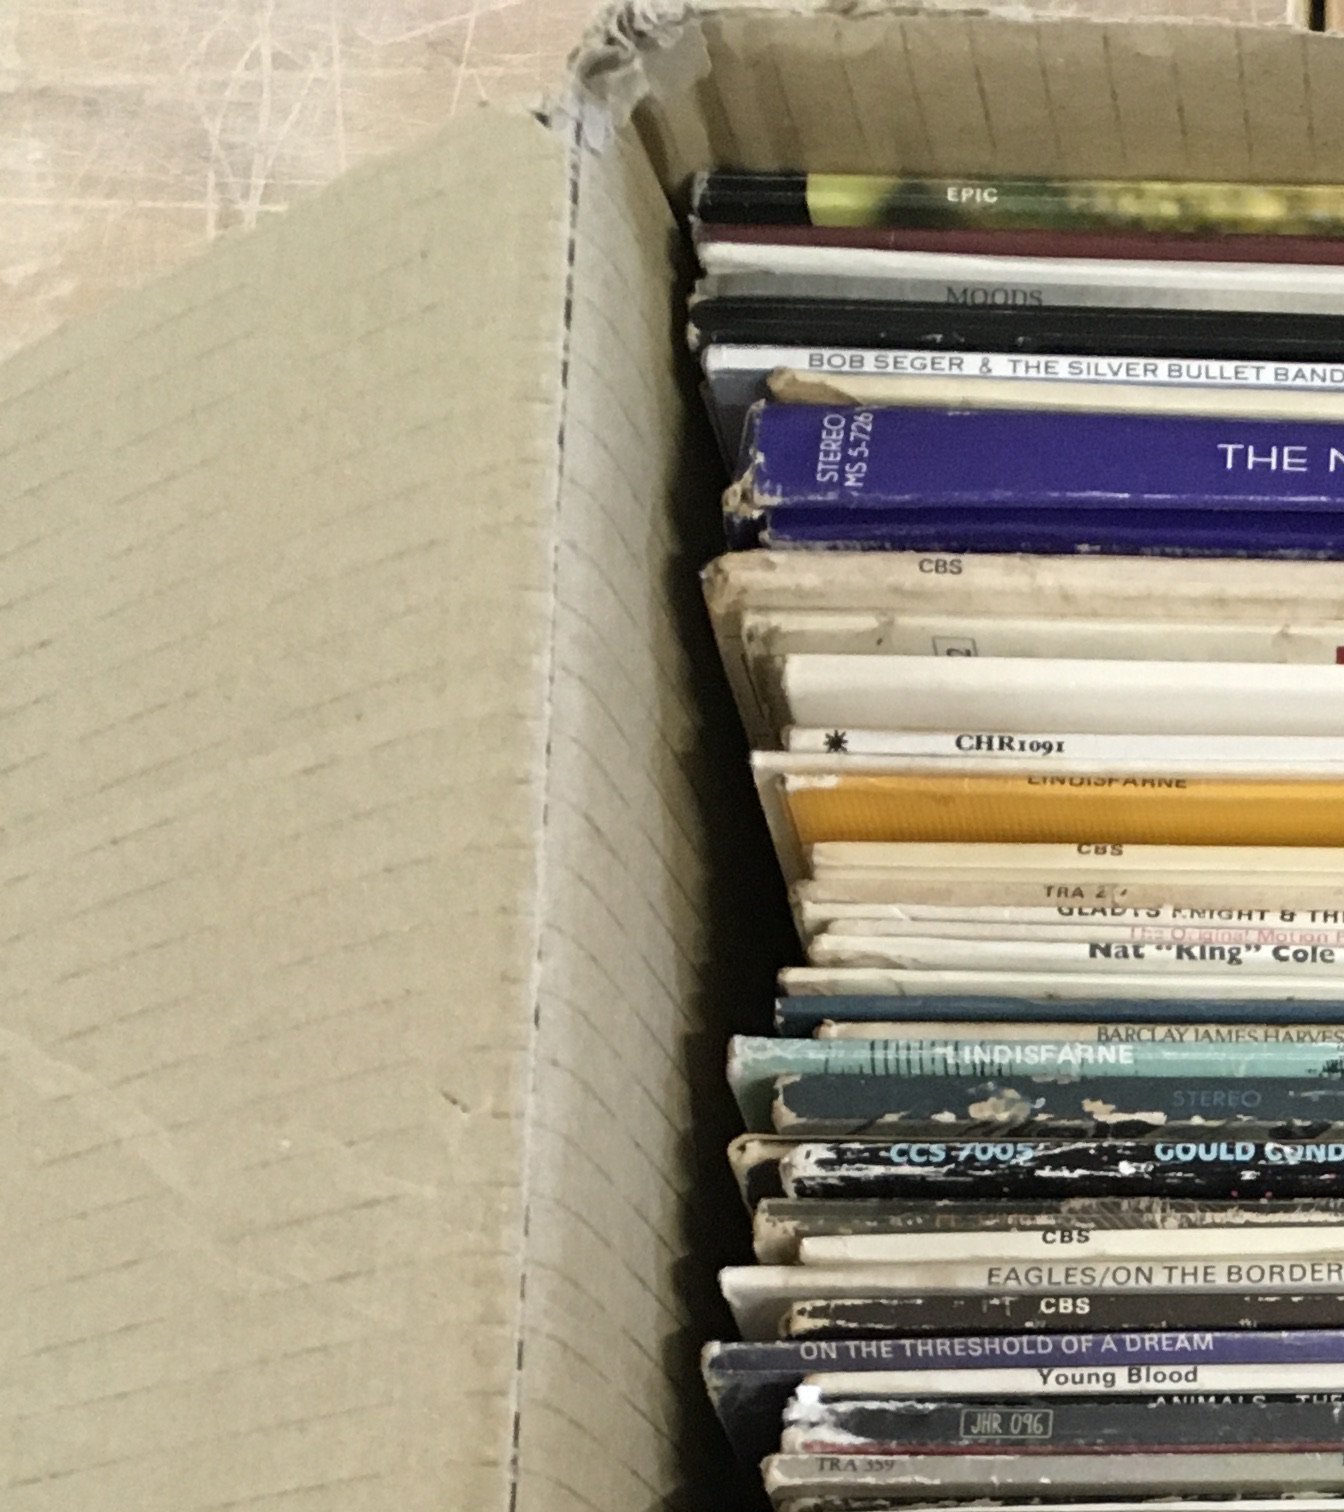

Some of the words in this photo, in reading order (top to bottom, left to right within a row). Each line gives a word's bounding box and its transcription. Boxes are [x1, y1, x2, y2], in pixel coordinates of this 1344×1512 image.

[947, 187, 998, 203] EPIC
[808, 353, 866, 369] BOB
[874, 355, 964, 371] SEGER
[979, 358, 993, 374] &
[1009, 358, 1059, 375] THE
[1067, 360, 1158, 377] SILVER
[1167, 363, 1264, 380] BULLET
[1274, 366, 1344, 383] BAND
[817, 413, 846, 483] STEREO
[1217, 443, 1308, 472] THE
[844, 459, 866, 487] MS
[1162, 1265, 1216, 1284] THE
[1226, 1263, 1344, 1282] BORDER
[800, 1341, 837, 1360] ON
[845, 1340, 894, 1359] THE
[902, 1335, 1054, 1357] THRESHOLD
[1061, 1336, 1093, 1354] OF
[1100, 1335, 1119, 1353] A
[1126, 1333, 1214, 1352] DREAM
[1037, 1369, 1115, 1388] Young
[1127, 1366, 1198, 1384] Blood
[970, 1412, 1001, 1433] JHR
